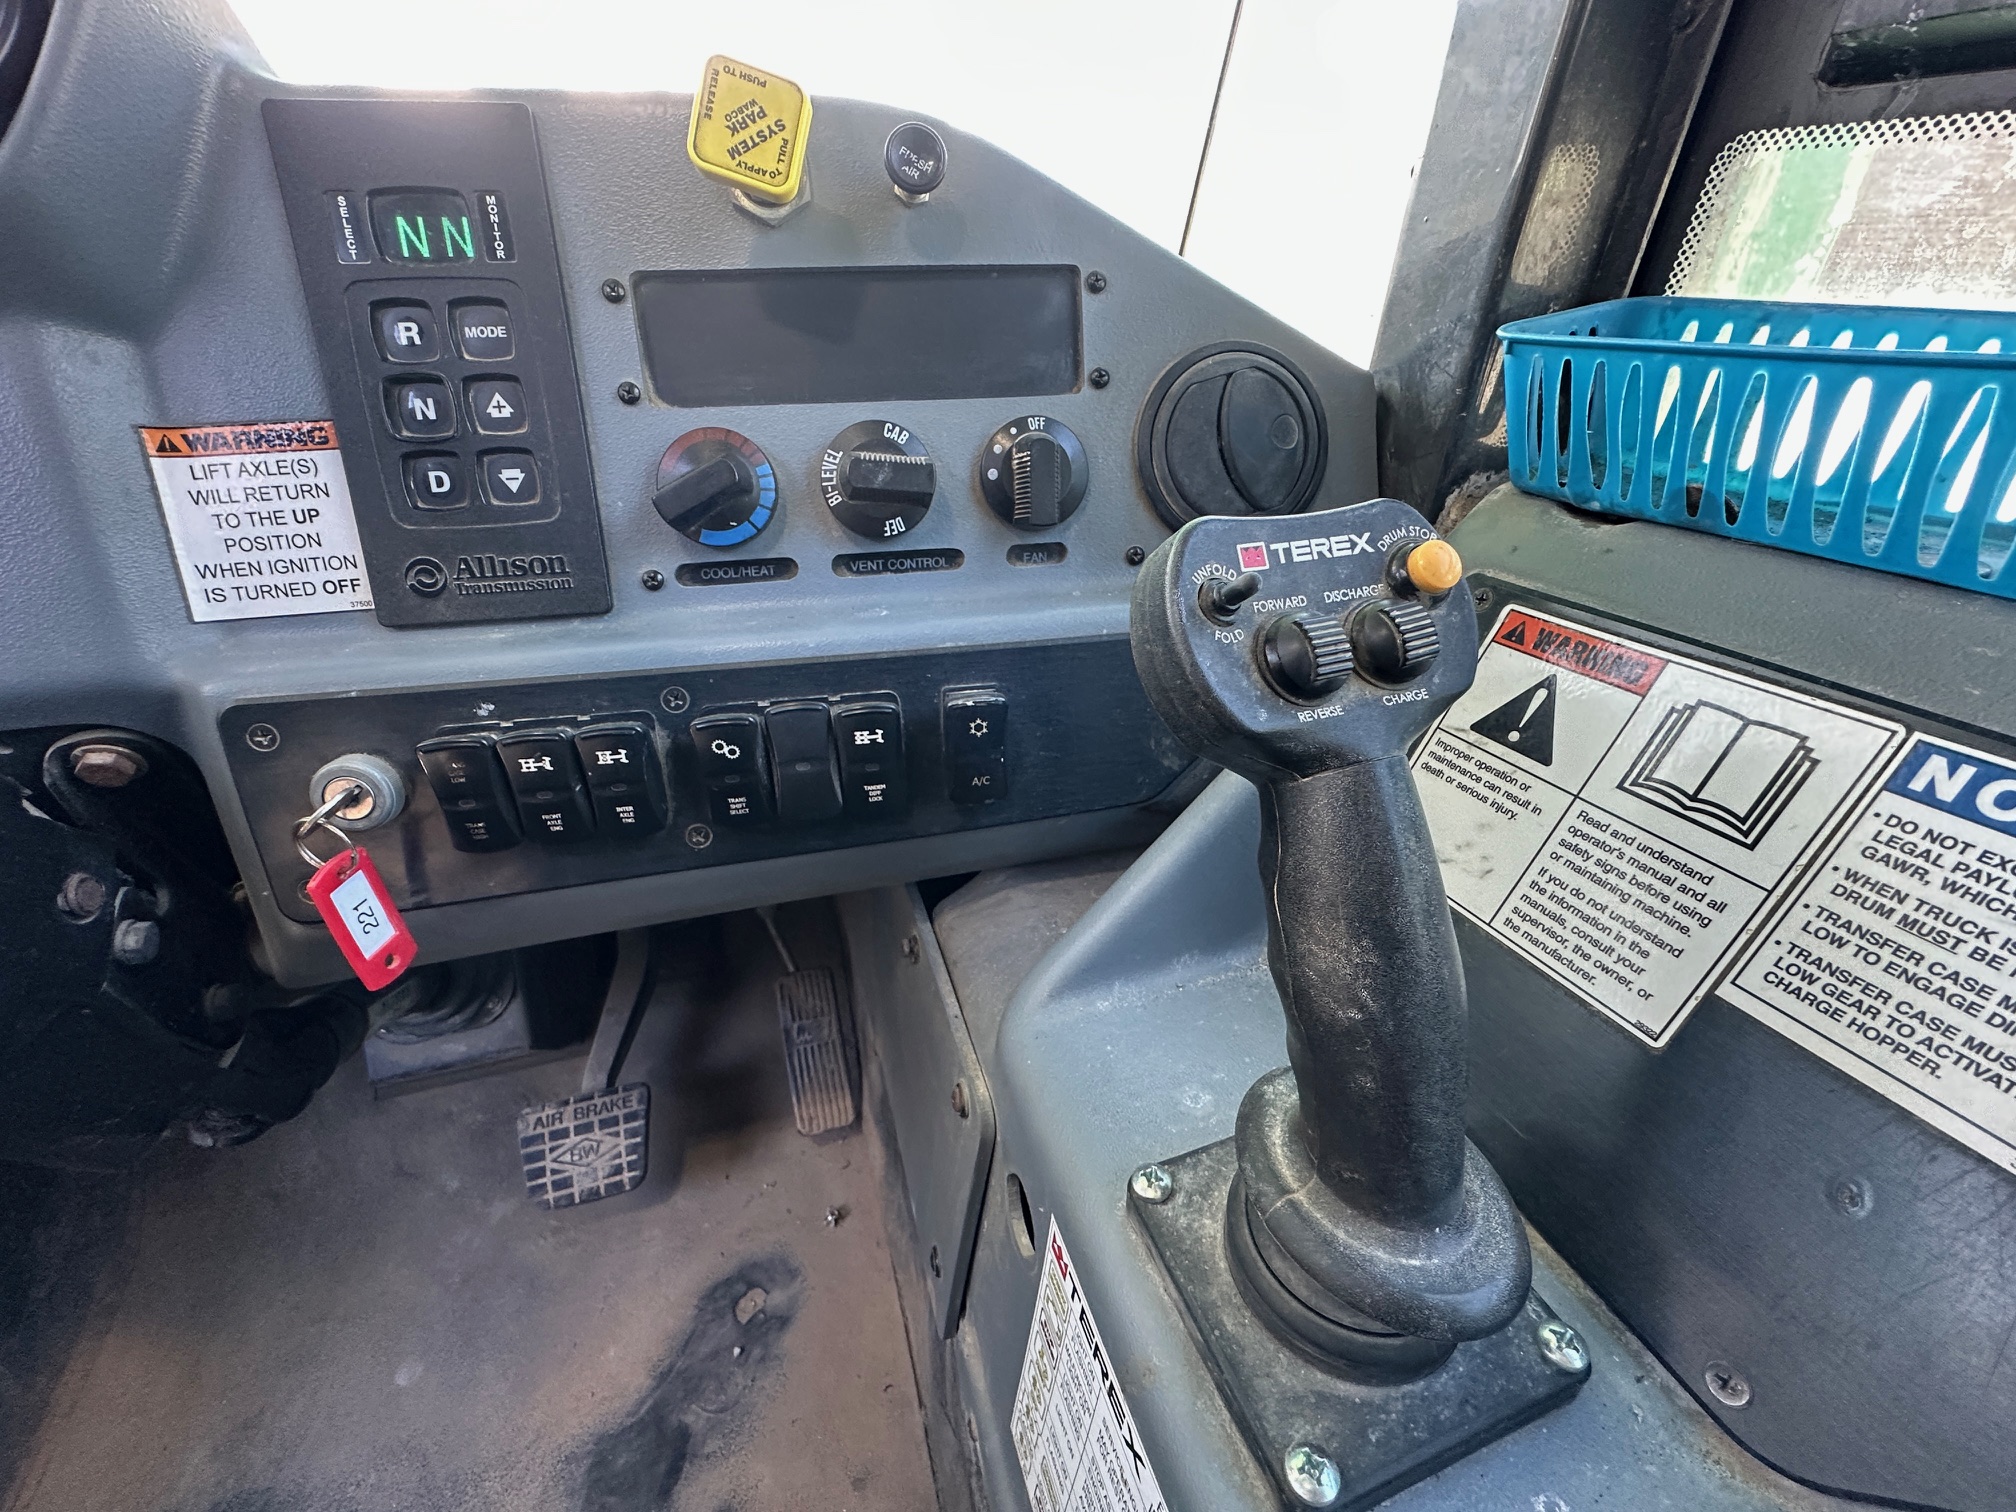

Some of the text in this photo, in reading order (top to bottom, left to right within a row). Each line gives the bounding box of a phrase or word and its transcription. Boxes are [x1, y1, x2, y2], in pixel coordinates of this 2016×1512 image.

[723, 65, 767, 88] PUSH TO
[704, 68, 719, 120] RELEASE
[724, 98, 759, 122] WABCO
[725, 105, 767, 137] PARK
[727, 119, 786, 161] SYSTEM
[777, 137, 789, 165] PULL
[736, 160, 783, 179] TO APPLY
[901, 165, 920, 180] AIR
[337, 196, 357, 260] SELECT
[485, 195, 505, 259] MONITOR
[397, 322, 421, 346] R
[465, 326, 507, 338] MODE
[413, 397, 437, 420] N
[1027, 417, 1046, 432] OFF
[180, 426, 330, 453] WARNING
[883, 422, 910, 446] CAB
[189, 458, 318, 480] LIFT AXLE(S)
[428, 471, 450, 493] D
[821, 447, 845, 508] BI-LEVEL
[188, 483, 330, 506] WILL RETURN
[211, 508, 320, 529] TO THE UP
[883, 516, 906, 538] DEF
[224, 532, 322, 553] POSITION
[1270, 532, 1375, 564] TEREX
[1377, 526, 1407, 552] DRUM
[194, 554, 358, 579] WHEN IGNITION
[453, 553, 571, 580] Allison
[701, 563, 776, 580] COOL/HEAT
[850, 555, 950, 573] VENT CONTROL
[1023, 551, 1048, 564] FAN
[453, 576, 574, 596] Transmission
[1192, 564, 1237, 585] UNFOLD
[204, 578, 361, 604] IS TURNED OFF
[350, 600, 373, 608] 37500
[1253, 595, 1307, 613] FORWARD
[1215, 629, 1244, 644] FOLD
[1532, 627, 1649, 687] WARNING
[1383, 689, 1429, 706] CHARGE
[1297, 705, 1344, 723] REVERSE
[972, 776, 990, 786] A/C
[1434, 737, 1532, 793] Improper operation or
[1421, 762, 1518, 820] death or serious injury.
[1427, 750, 1543, 816] maintenance can result in
[1577, 809, 1715, 886] Read and understand
[1883, 813, 1919, 835] DO
[1920, 828, 1976, 856] NOT
[1567, 824, 1728, 914] operator's manual and all
[1860, 845, 1932, 886] GAWR,
[1871, 829, 2016, 898] LEGAL PAYL
[1550, 851, 1692, 938] or maintaining machine.
[1558, 837, 1713, 929] safety signs before using
[352, 898, 379, 934] 221
[1529, 879, 1651, 959] the information in the
[1537, 866, 1685, 959] If you do not understand
[1844, 867, 1910, 906] WHEN
[1912, 896, 1999, 945] TRUCK
[1519, 892, 1647, 977] manuals, consult your
[1830, 883, 2009, 972] DRUM MUST BE
[1503, 916, 1597, 987] the manufacturer.
[1511, 905, 1654, 1001] supervisor, the owner, or
[1815, 904, 1926, 967] TRANSFER
[1927, 962, 1998, 1001] CASE
[1801, 920, 1852, 949] LOW
[1852, 943, 1882, 966] TO
[1882, 961, 1986, 1019] ENGAGE
[1773, 956, 1822, 986] LOW
[1821, 982, 1882, 1022] GEAR
[1885, 1014, 1916, 1039] TO
[1786, 941, 1893, 1006] TRANSFER
[1895, 1001, 1962, 1042] CASE
[1763, 970, 1942, 1080] CHARGE HOPPER.
[533, 1095, 634, 1131] AIR BRAKE
[1068, 1269, 1147, 1484] TEREX
